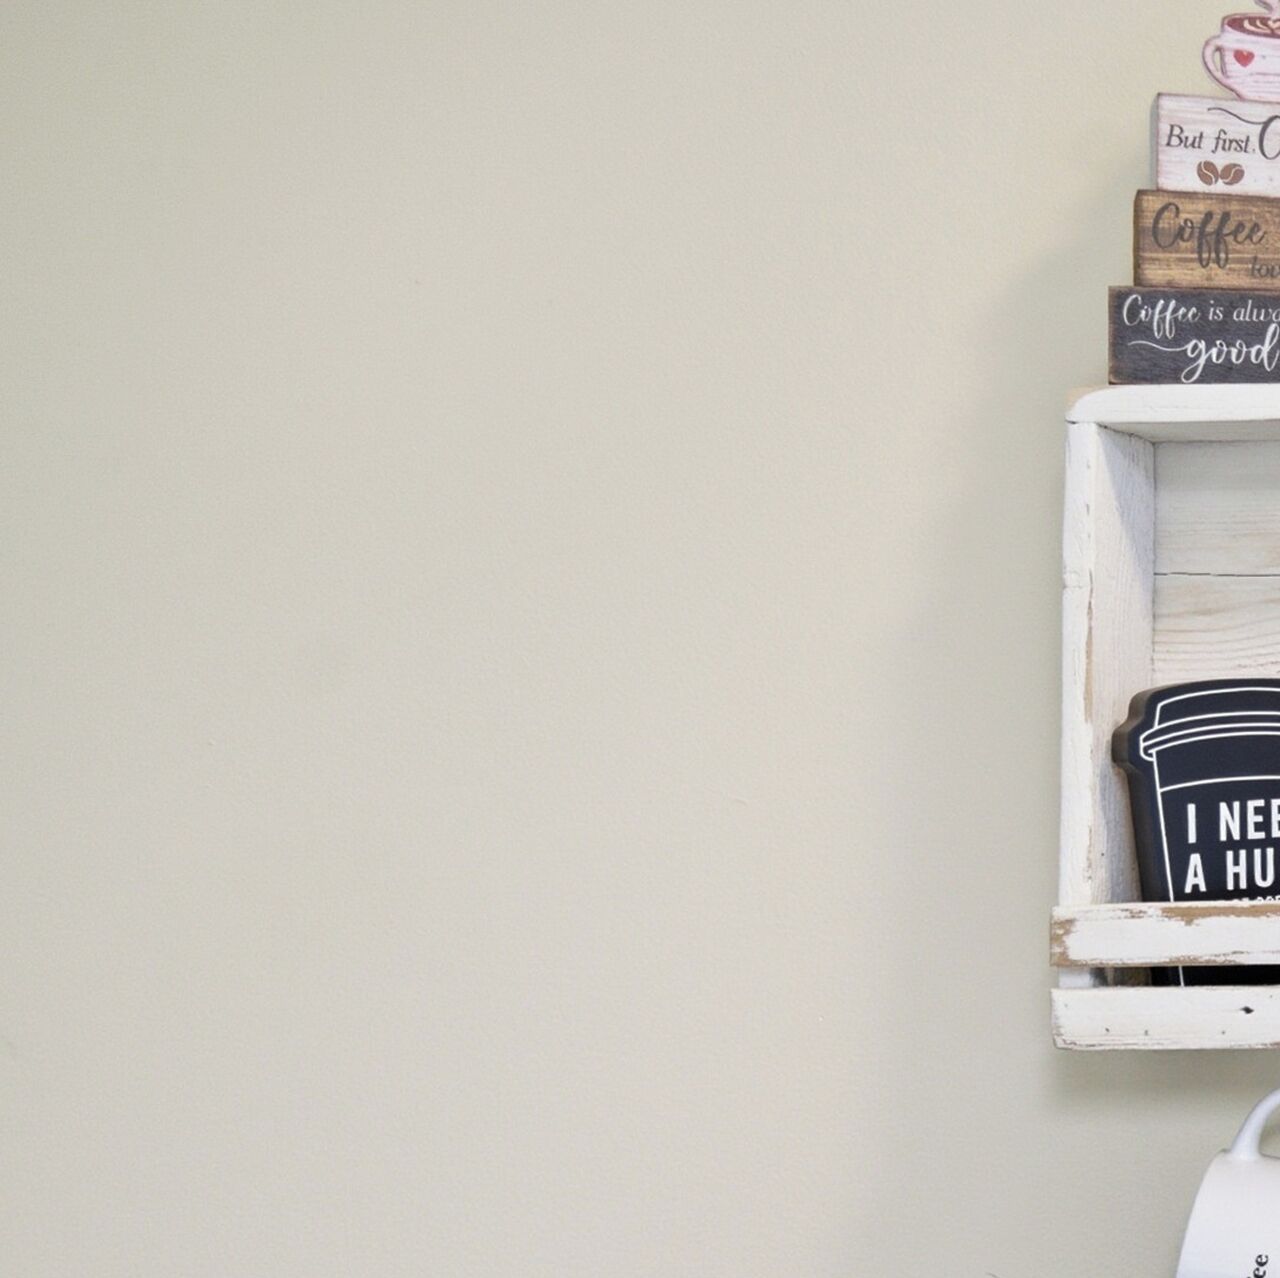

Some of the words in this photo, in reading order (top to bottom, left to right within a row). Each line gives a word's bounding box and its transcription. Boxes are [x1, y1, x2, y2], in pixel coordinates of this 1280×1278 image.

[1165, 124, 1204, 150] But
[1152, 202, 1266, 269] Coffee
[1123, 294, 1201, 339] Coffee
[1209, 300, 1223, 321] is
[1178, 323, 1280, 383] good
[1187, 803, 1197, 844] I
[1184, 853, 1207, 894] A
